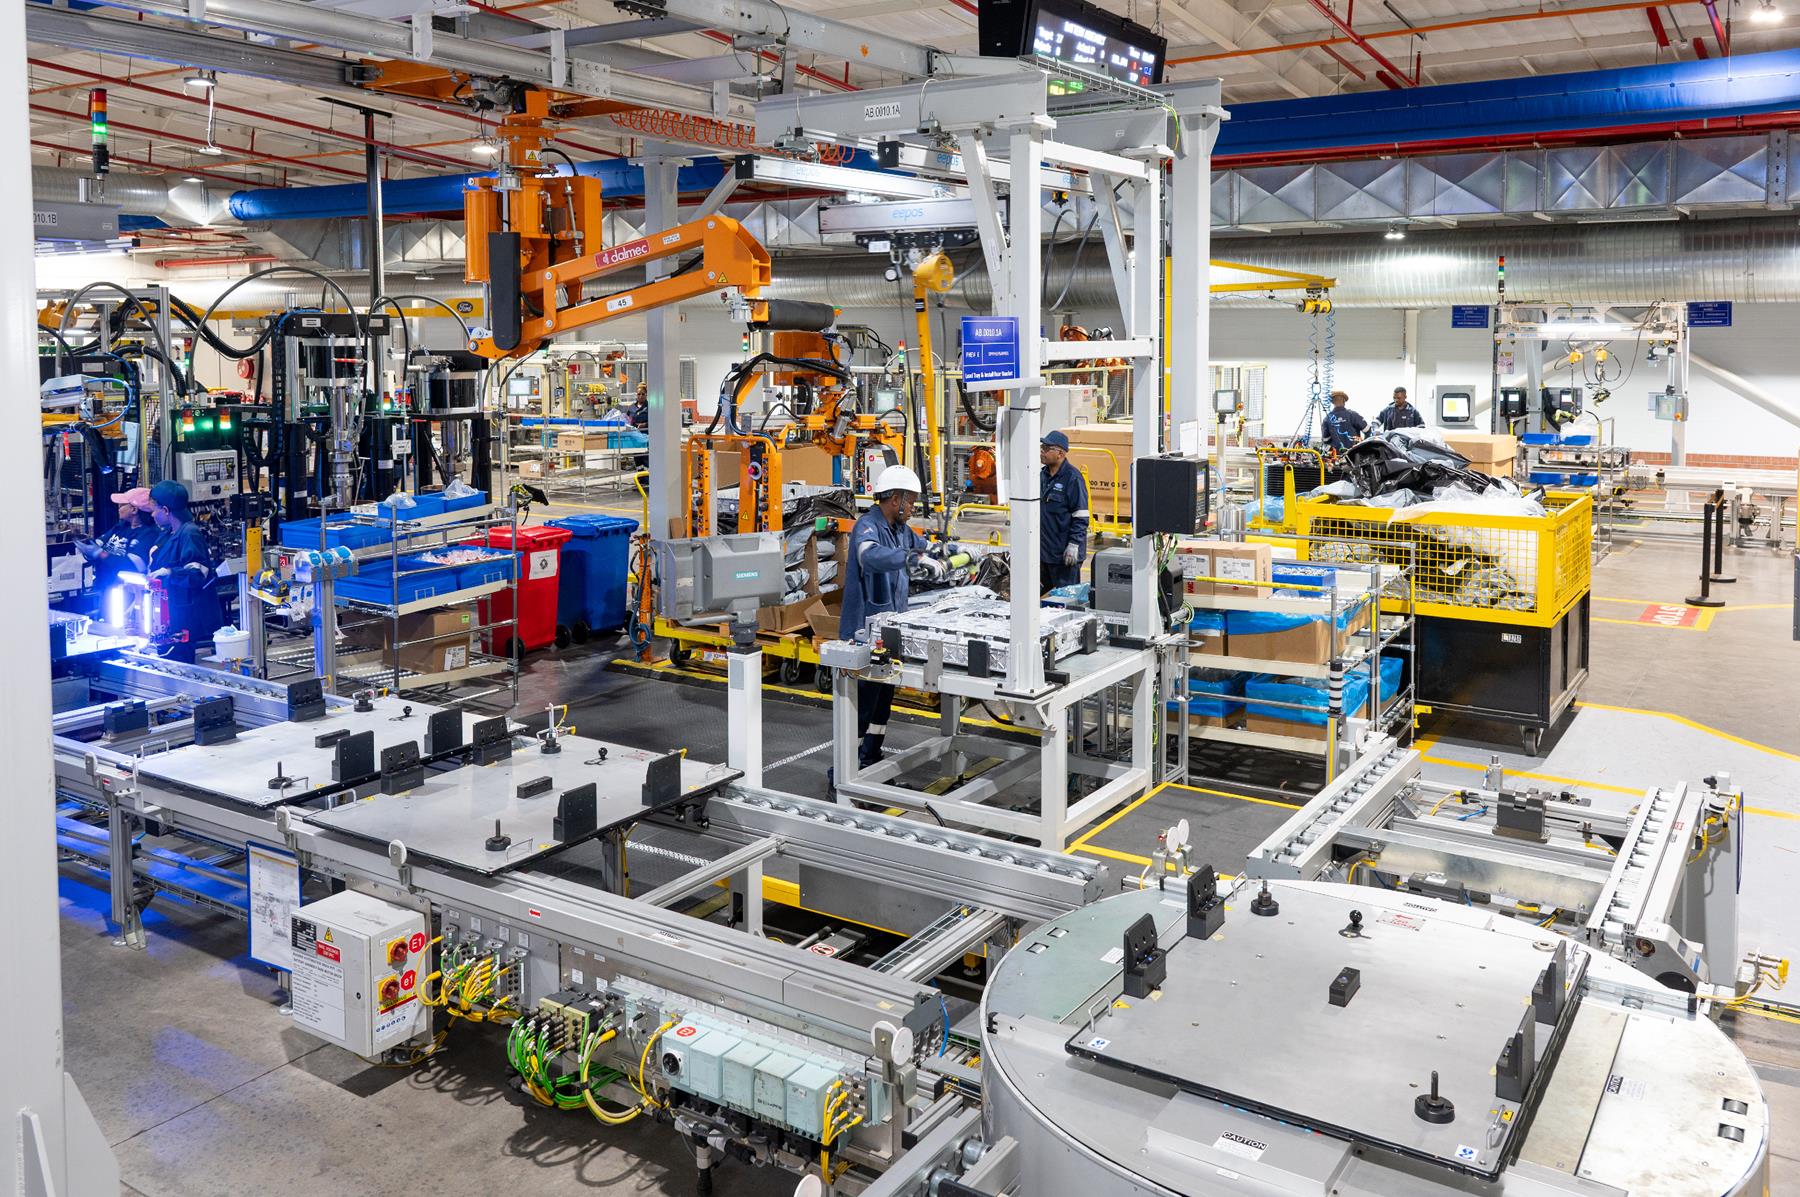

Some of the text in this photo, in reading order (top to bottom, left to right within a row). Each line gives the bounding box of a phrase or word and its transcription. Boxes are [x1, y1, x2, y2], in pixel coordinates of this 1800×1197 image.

[936, 153, 960, 167] eepos
[891, 207, 924, 221] eepos
[611, 244, 648, 263] dalmec
[618, 299, 627, 307] 45
[736, 571, 758, 579] SIEMENS
[1652, 605, 1688, 626] STOP
[412, 937, 422, 949] E1
[404, 974, 413, 986] e1
[1221, 1131, 1267, 1150] CAUTION
